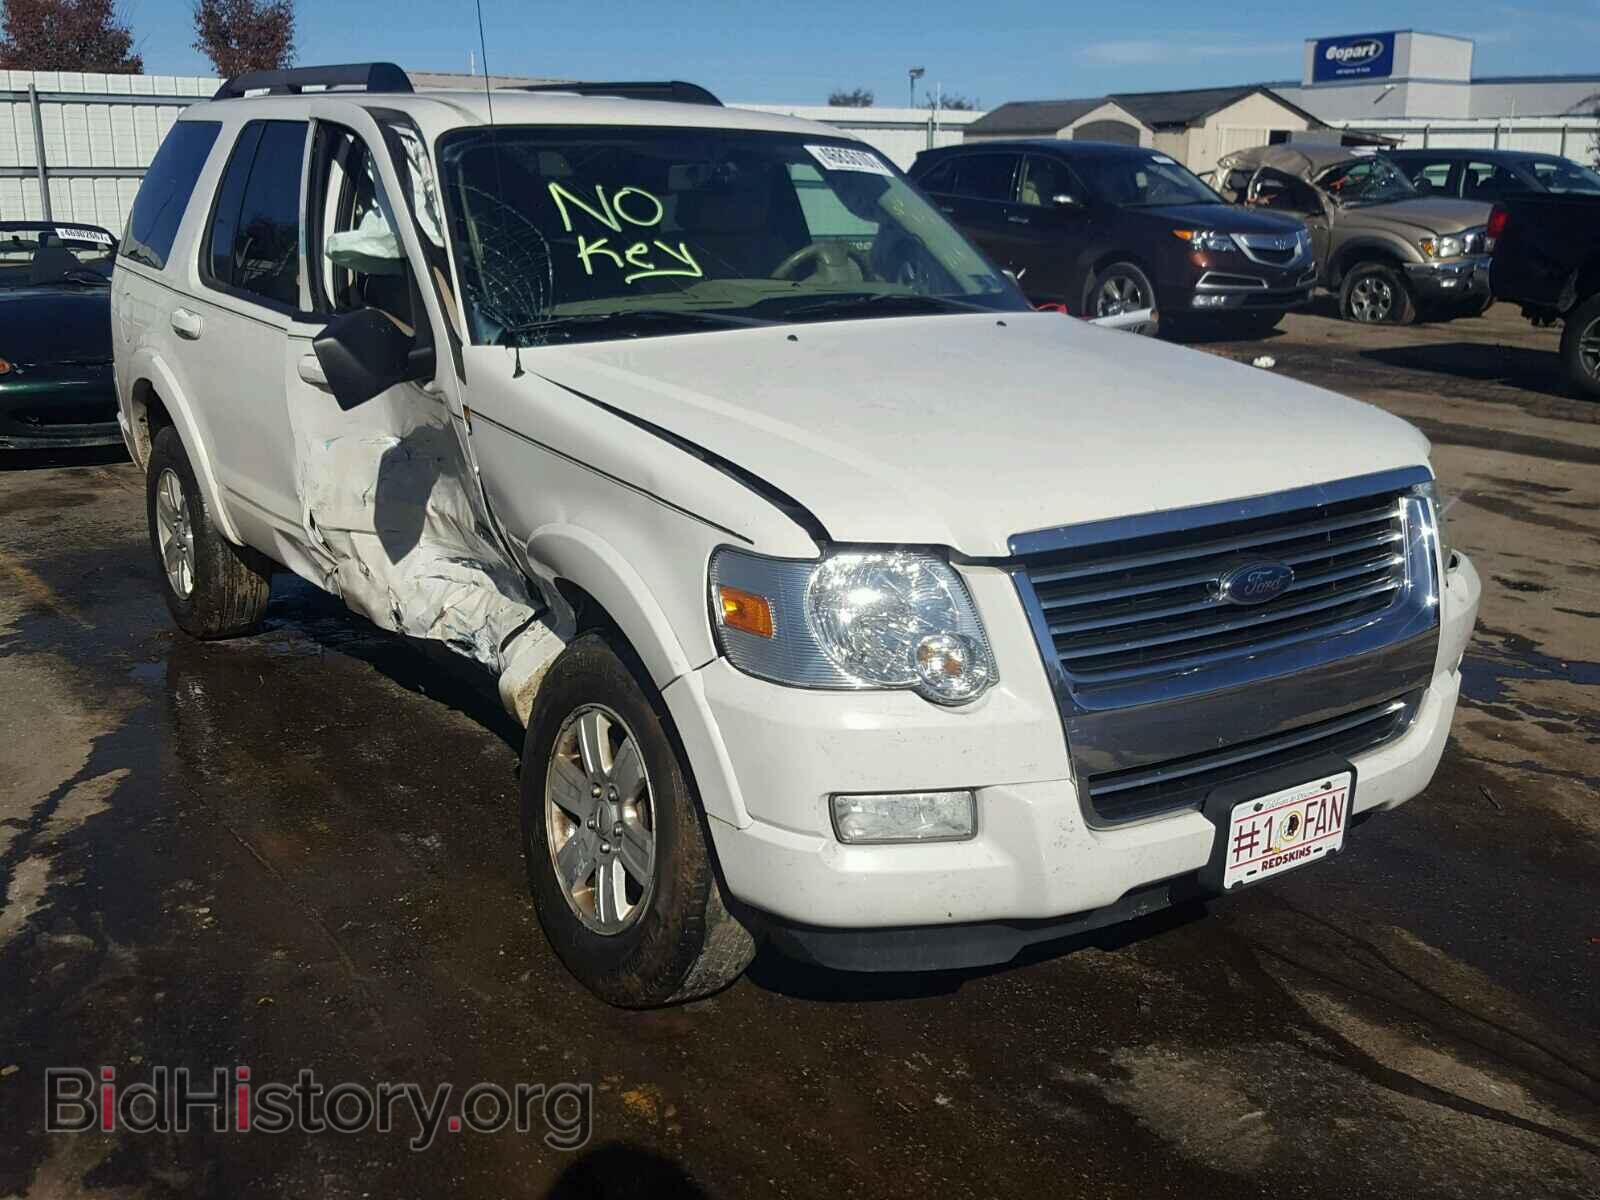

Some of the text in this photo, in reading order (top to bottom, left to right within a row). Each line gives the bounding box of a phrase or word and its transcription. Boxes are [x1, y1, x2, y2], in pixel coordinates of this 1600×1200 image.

[1325, 42, 1378, 62] Copart
[548, 182, 663, 233] NO
[1244, 569, 1281, 594] Ford
[1233, 815, 1274, 862] #1
[1303, 793, 1345, 841] FAN
[1261, 846, 1312, 872] REDSKINS
